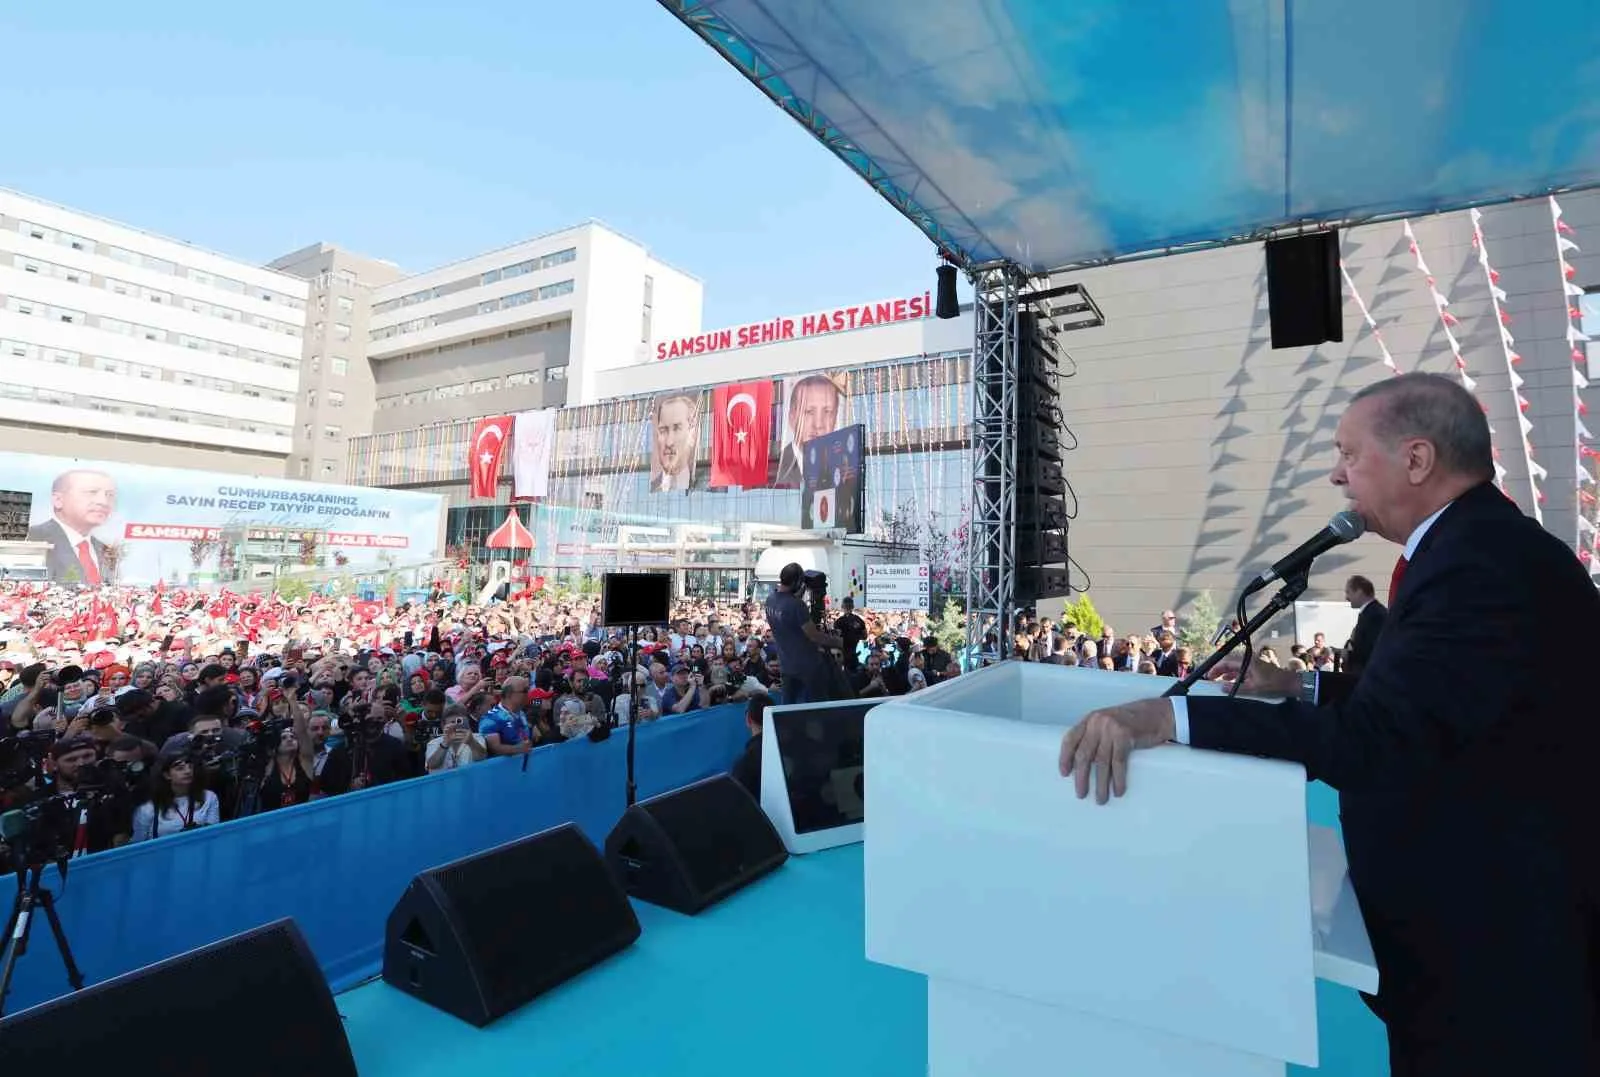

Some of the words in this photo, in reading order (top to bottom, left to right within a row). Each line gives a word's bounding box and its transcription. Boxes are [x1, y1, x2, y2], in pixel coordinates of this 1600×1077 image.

[657, 330, 731, 360] SAMSUN
[737, 317, 795, 347] ŞEHİR
[802, 291, 932, 336] HASTANESİ
[166, 494, 215, 507] SAYIN
[218, 498, 266, 511] RECEP
[269, 502, 315, 514] TAYYİP
[317, 504, 392, 519] ERDOĞAN'IN
[217, 486, 358, 506] CUMHURBAŞKANIMIZ
[131, 525, 206, 540] SAMSUN
